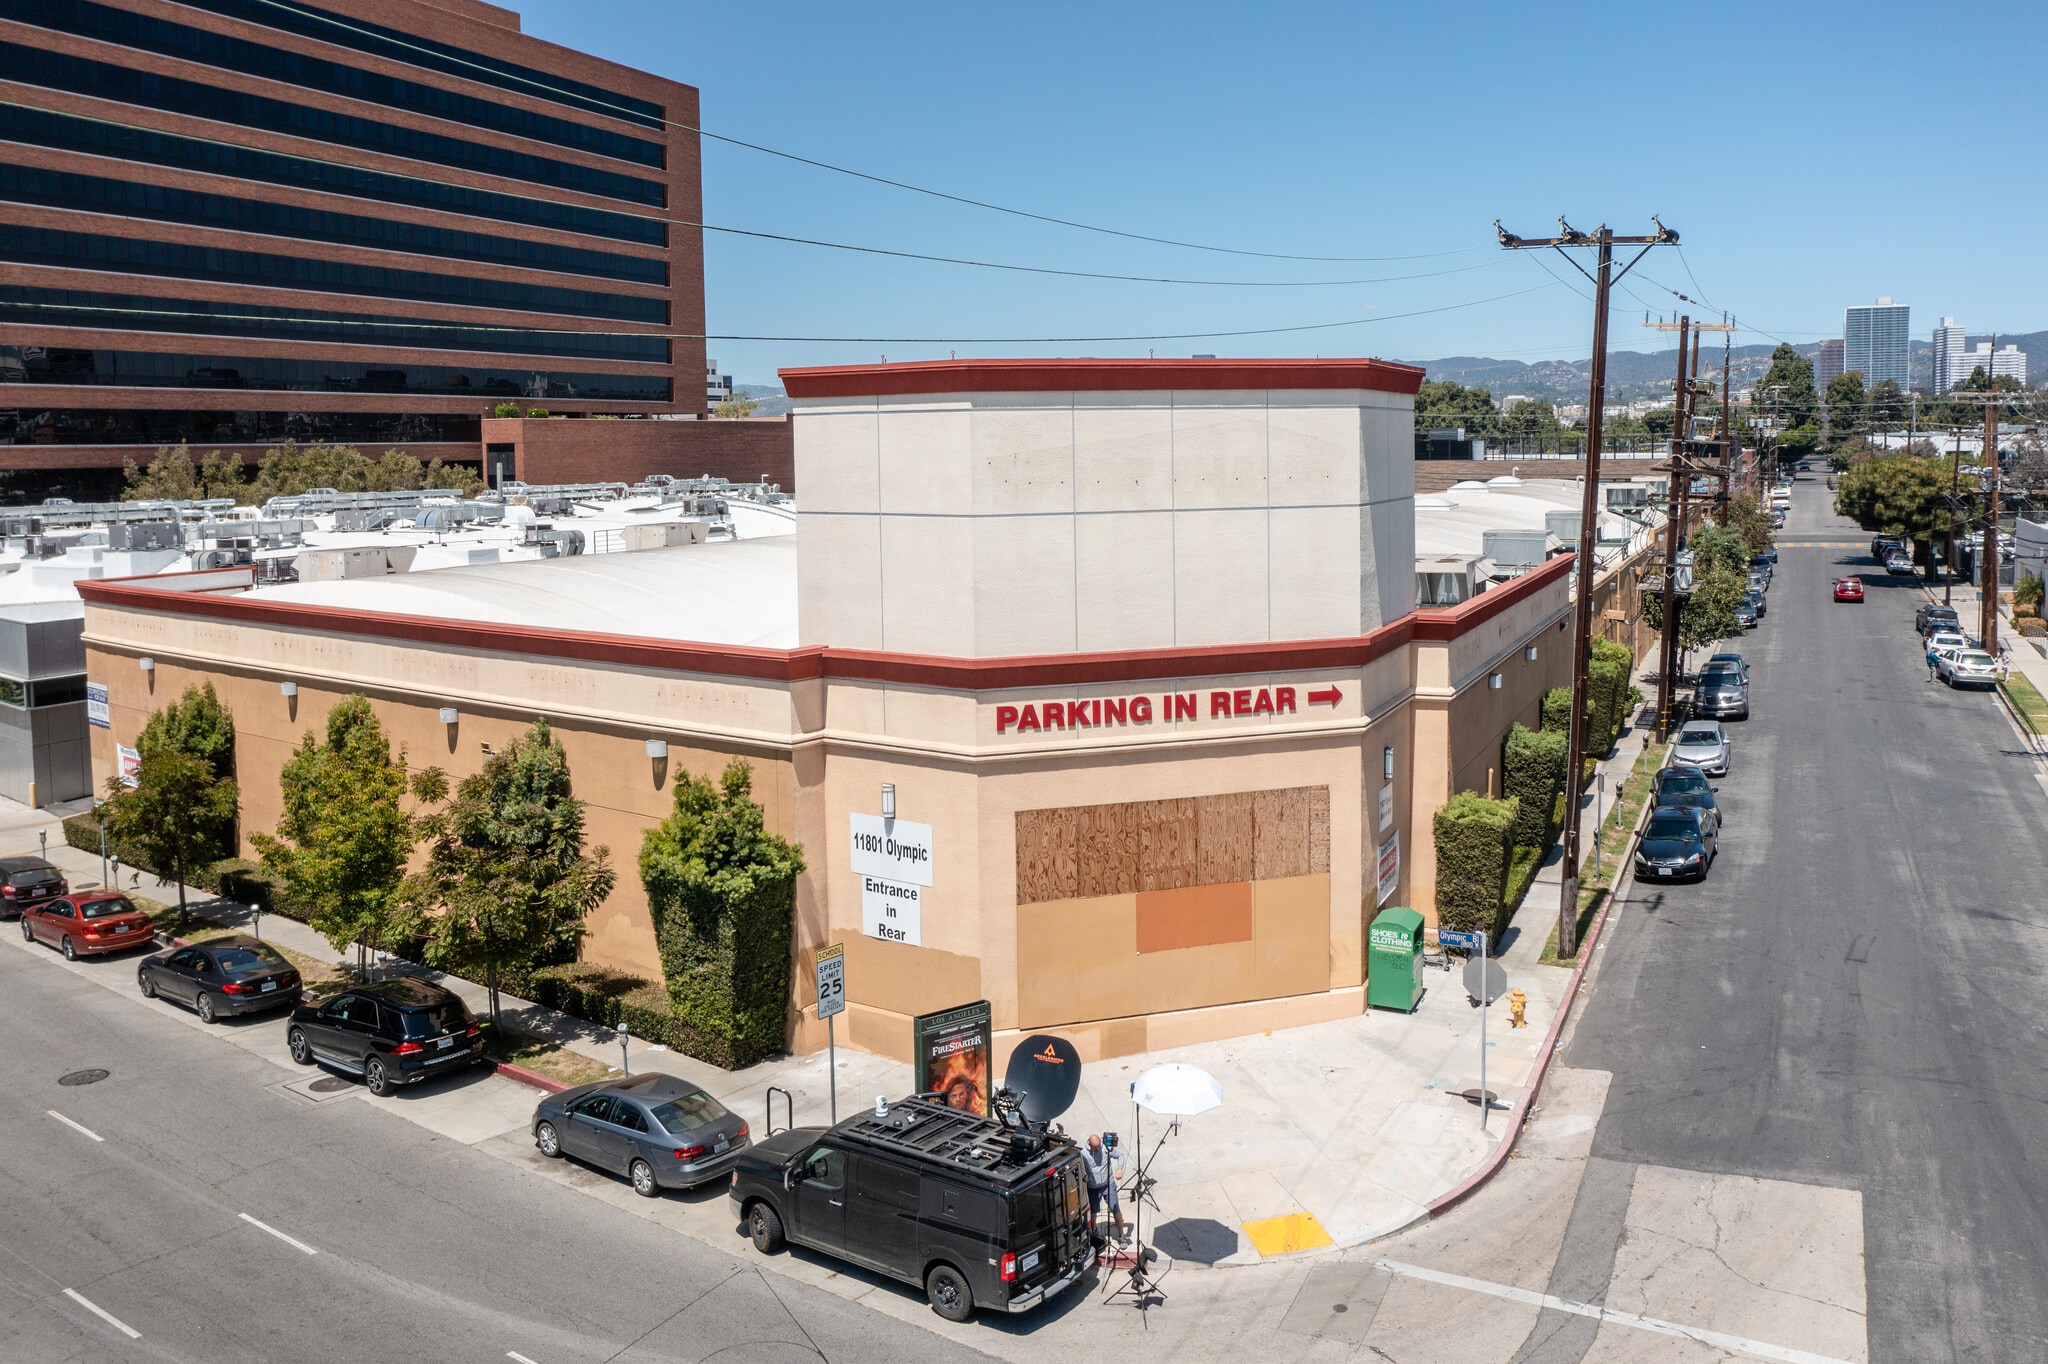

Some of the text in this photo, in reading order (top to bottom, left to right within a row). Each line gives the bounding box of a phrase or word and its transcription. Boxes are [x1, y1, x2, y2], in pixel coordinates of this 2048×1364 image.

[996, 687, 1297, 733] PARKING IN REAR
[854, 832, 928, 863] 11801 Olympic
[865, 878, 918, 900] Entrance
[886, 903, 897, 918] in
[878, 923, 906, 941] Rear
[1371, 928, 1398, 939] SHOES
[1440, 931, 1467, 943] Olympic
[1371, 936, 1412, 948] CLOTHING
[818, 947, 842, 960] SCHOOL
[819, 960, 842, 974] SPEED
[821, 969, 840, 982] LIMIT
[820, 978, 842, 999] 25
[932, 1008, 980, 1025] LOS ANGELES
